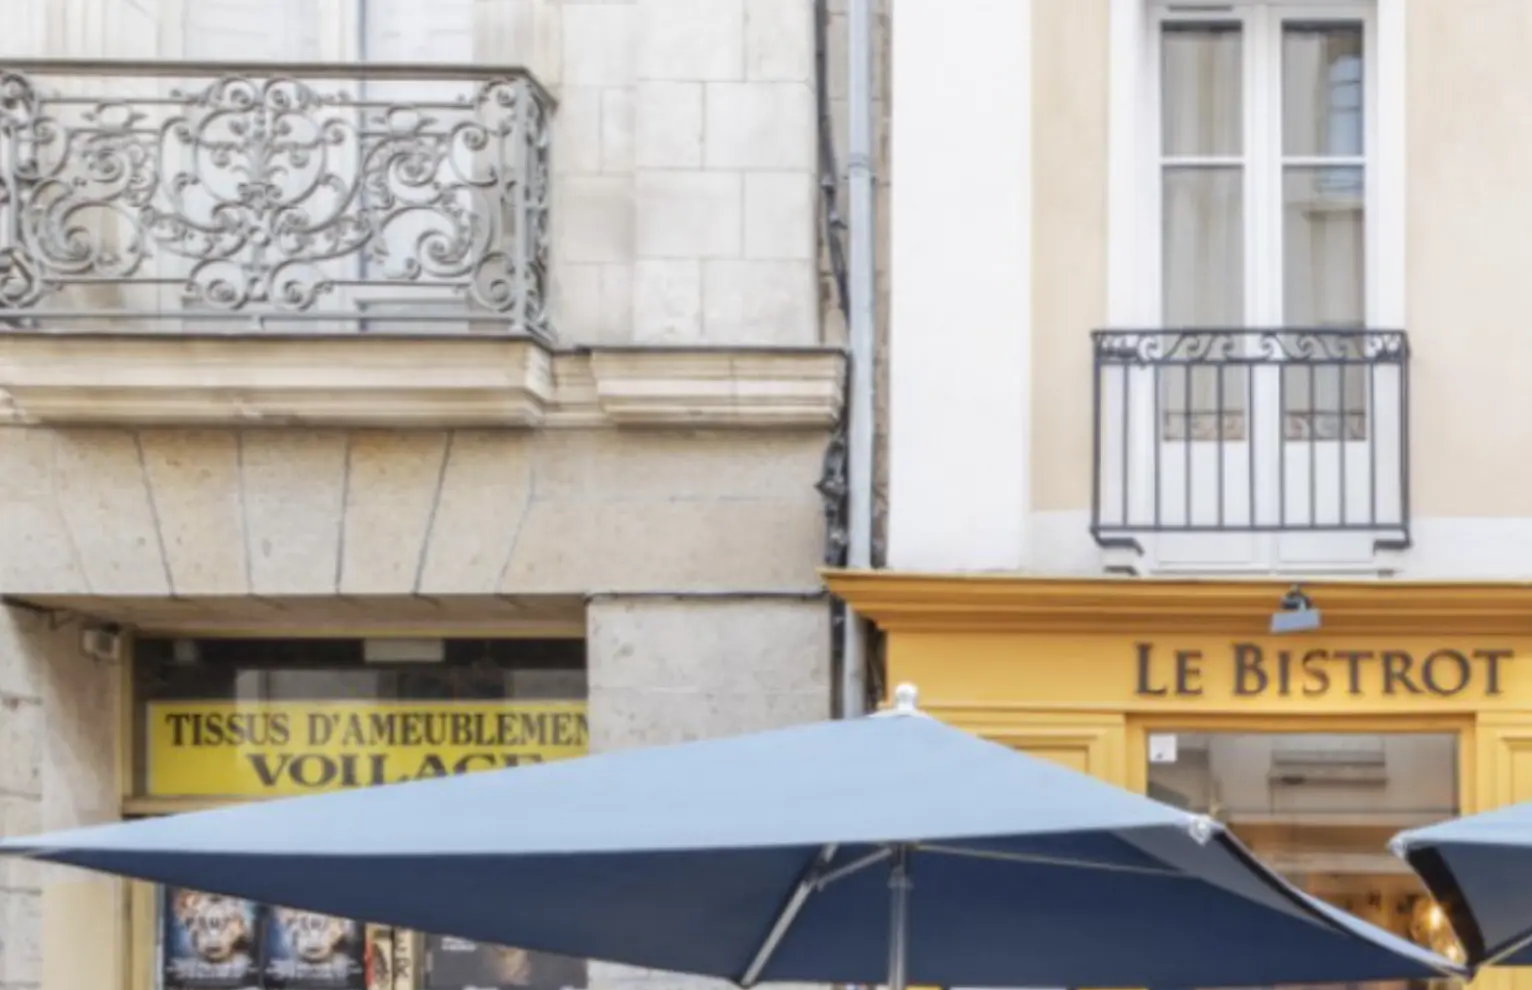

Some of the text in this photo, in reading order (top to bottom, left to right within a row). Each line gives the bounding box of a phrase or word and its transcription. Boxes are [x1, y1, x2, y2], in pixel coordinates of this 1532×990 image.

[1133, 641, 1203, 696] LE
[1231, 641, 1514, 697] BISTROT
[165, 711, 291, 746] TISSUS
